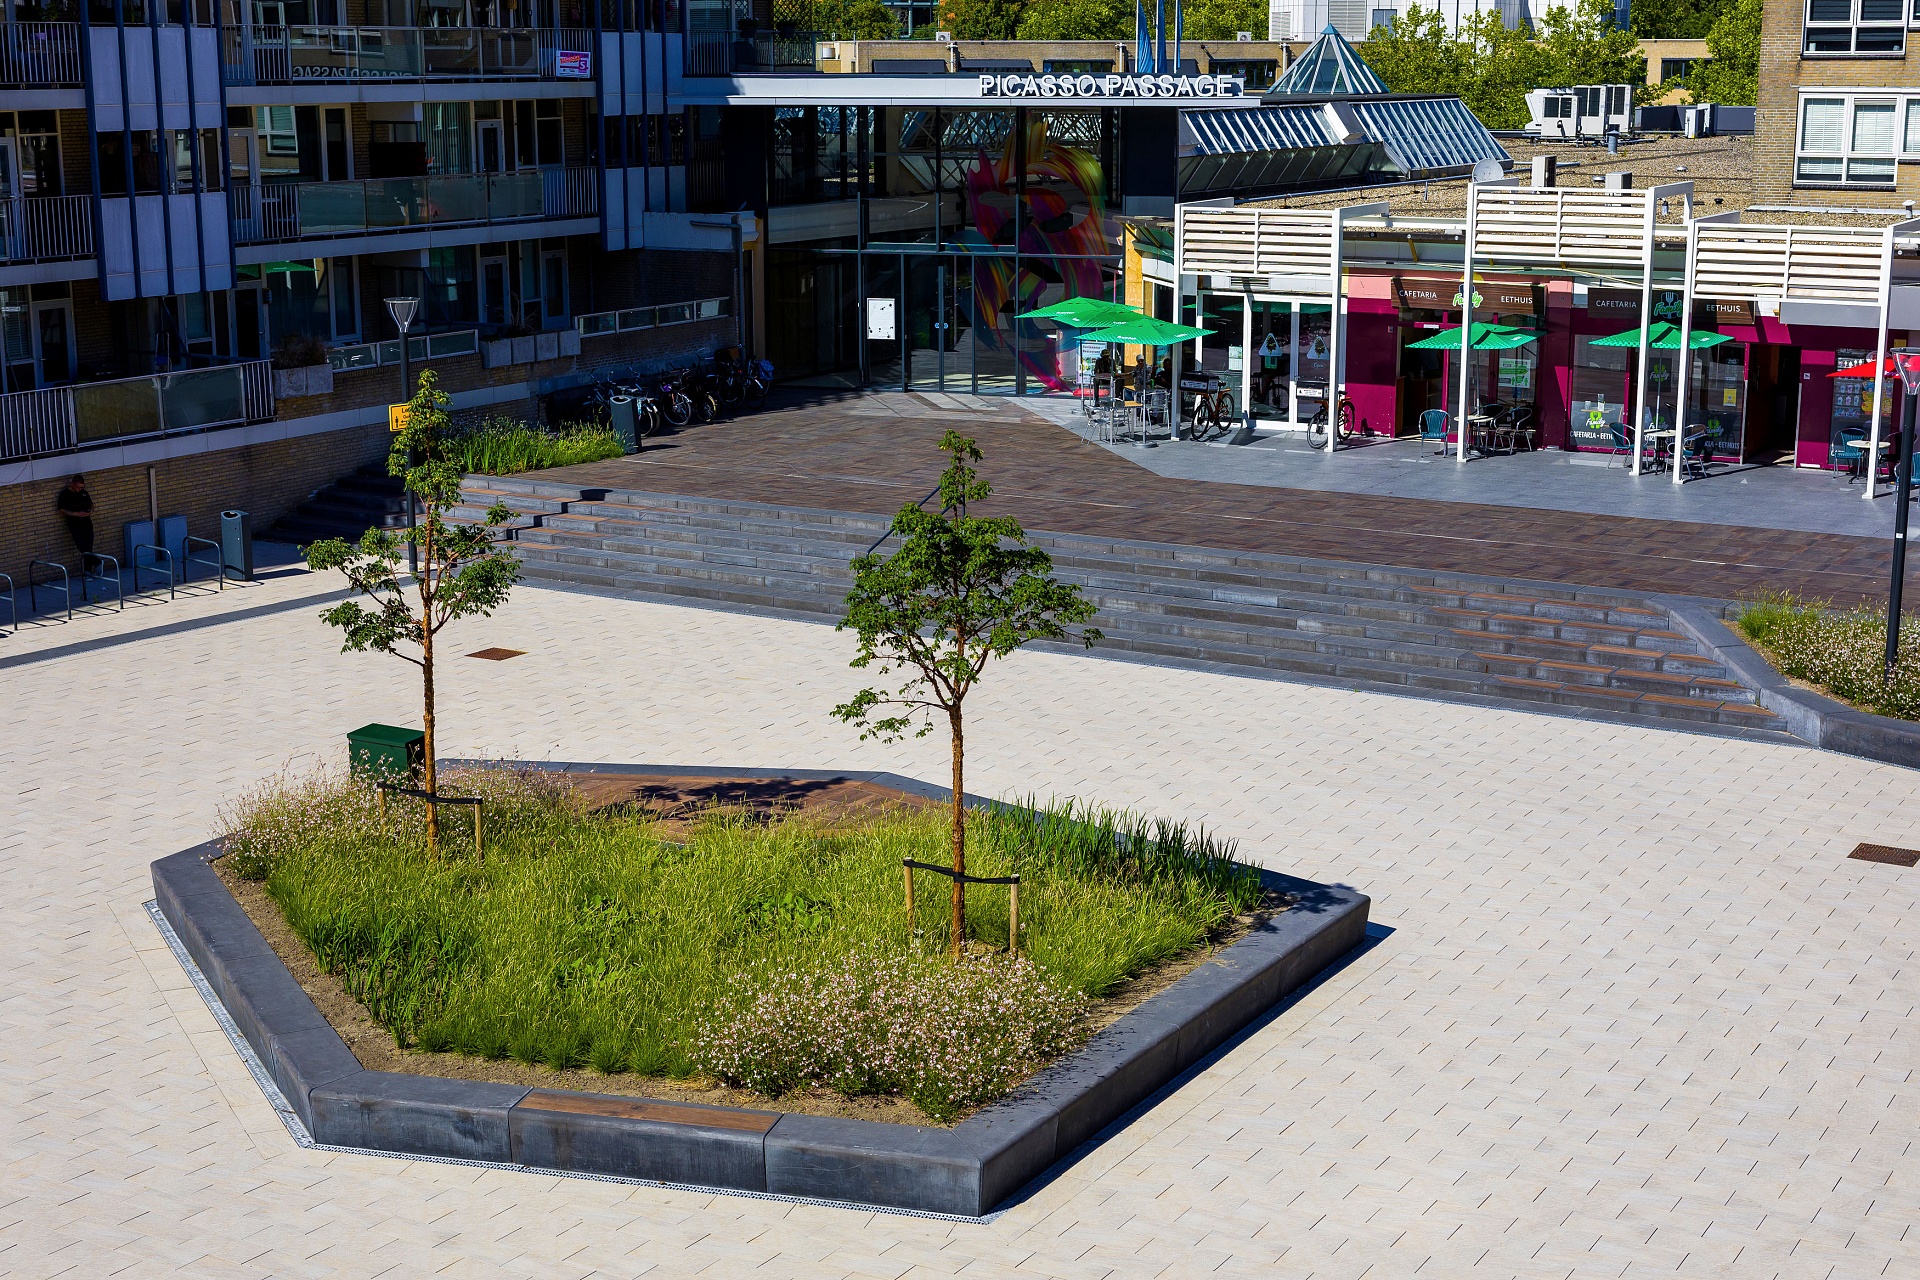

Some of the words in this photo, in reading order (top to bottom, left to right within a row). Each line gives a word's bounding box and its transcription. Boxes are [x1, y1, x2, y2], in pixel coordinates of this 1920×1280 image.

[979, 75, 1097, 97] PICASSO
[1105, 75, 1233, 97] PASSAGE
[1399, 290, 1437, 299] CAFETARIA
[1452, 291, 1484, 308] Faly
[1501, 296, 1533, 304] EETHUIS
[1595, 300, 1637, 308] CAFETARIA
[1653, 299, 1683, 317] Family
[1706, 304, 1741, 313] EETHUIS
[1570, 430, 1597, 439] CAFETARIA
[1600, 432, 1613, 440] EETH
[1718, 441, 1740, 449] EETHUIS
